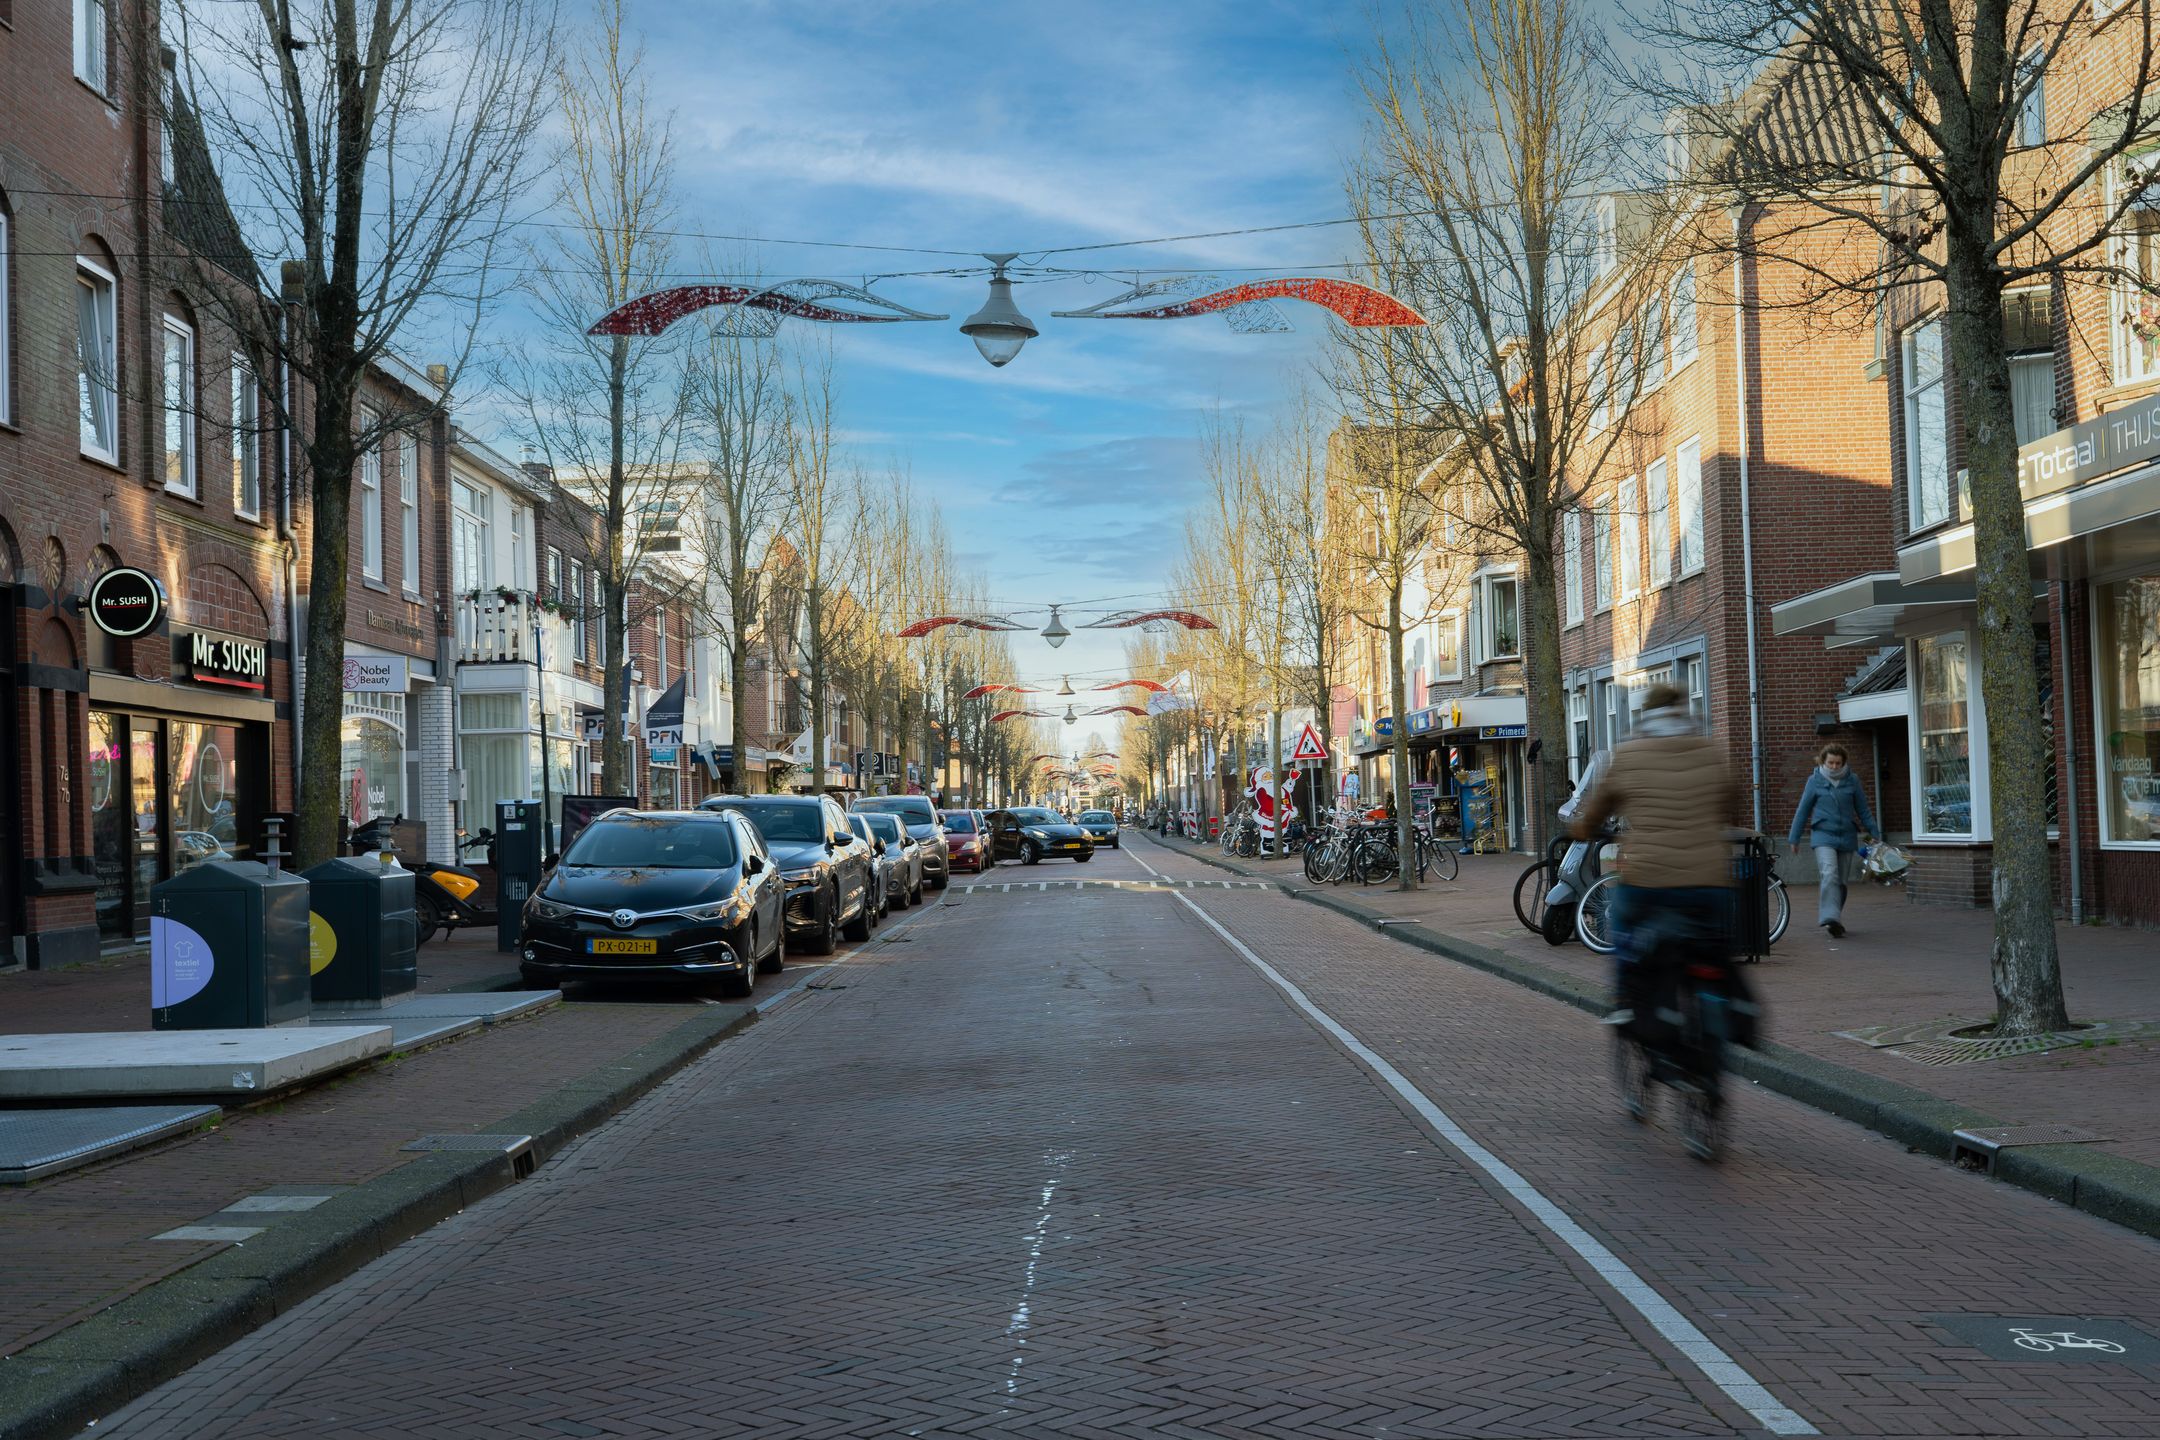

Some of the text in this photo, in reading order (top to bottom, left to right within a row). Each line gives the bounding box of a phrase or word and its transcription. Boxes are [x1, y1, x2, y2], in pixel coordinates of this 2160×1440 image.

[2027, 431, 2096, 482] Totaal
[102, 596, 147, 606] Mr. SUSHI
[193, 632, 265, 677] Mr. SUSHI
[360, 664, 390, 675] Nobel
[360, 676, 390, 686] Beauty
[649, 730, 683, 744] PFN
[1498, 727, 1526, 736] Primera
[2111, 754, 2152, 775] Vandaag
[367, 785, 385, 804] Nobel
[598, 941, 651, 952] PX-021-H
